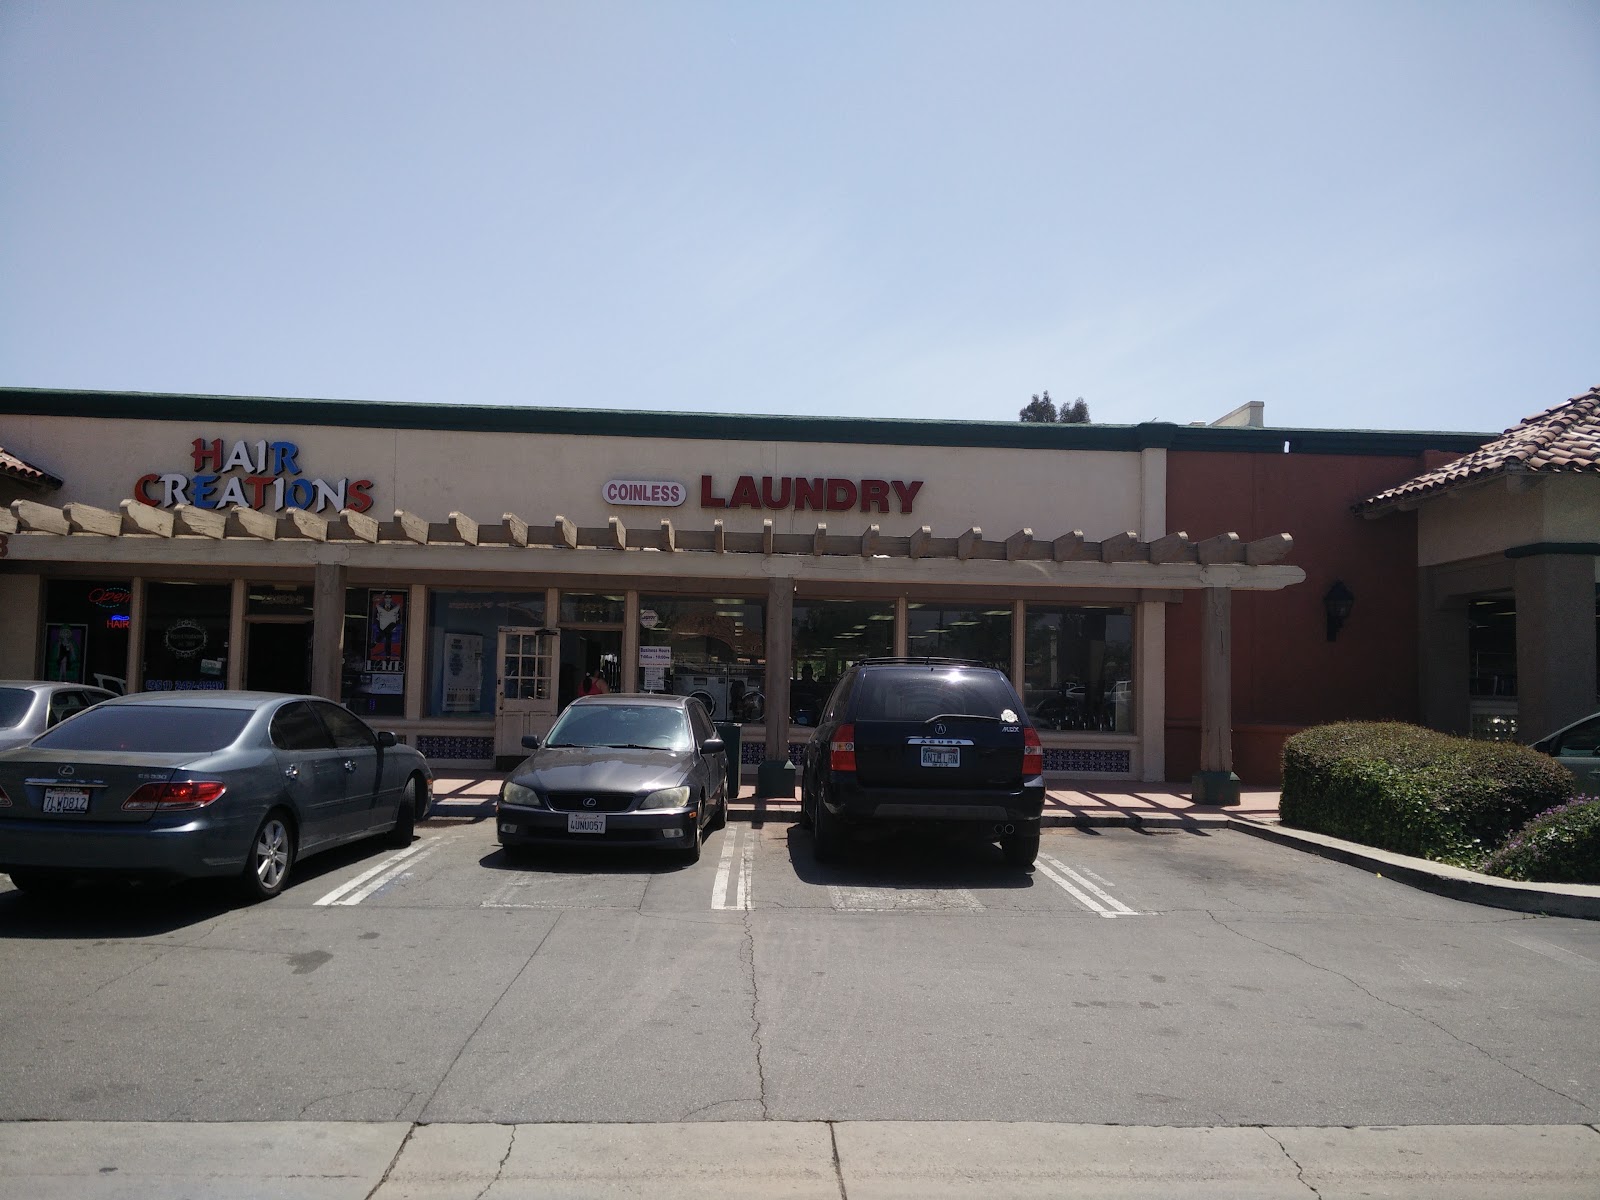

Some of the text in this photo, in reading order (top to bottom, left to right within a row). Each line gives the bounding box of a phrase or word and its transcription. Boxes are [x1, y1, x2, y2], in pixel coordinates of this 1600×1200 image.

[191, 438, 302, 475] HAIR
[134, 473, 373, 512] CREATIONS
[608, 483, 680, 502] COINLESS
[701, 475, 924, 514] LAUNDRY
[106, 620, 130, 629] HAIR
[570, 820, 604, 831] 4UNU057
